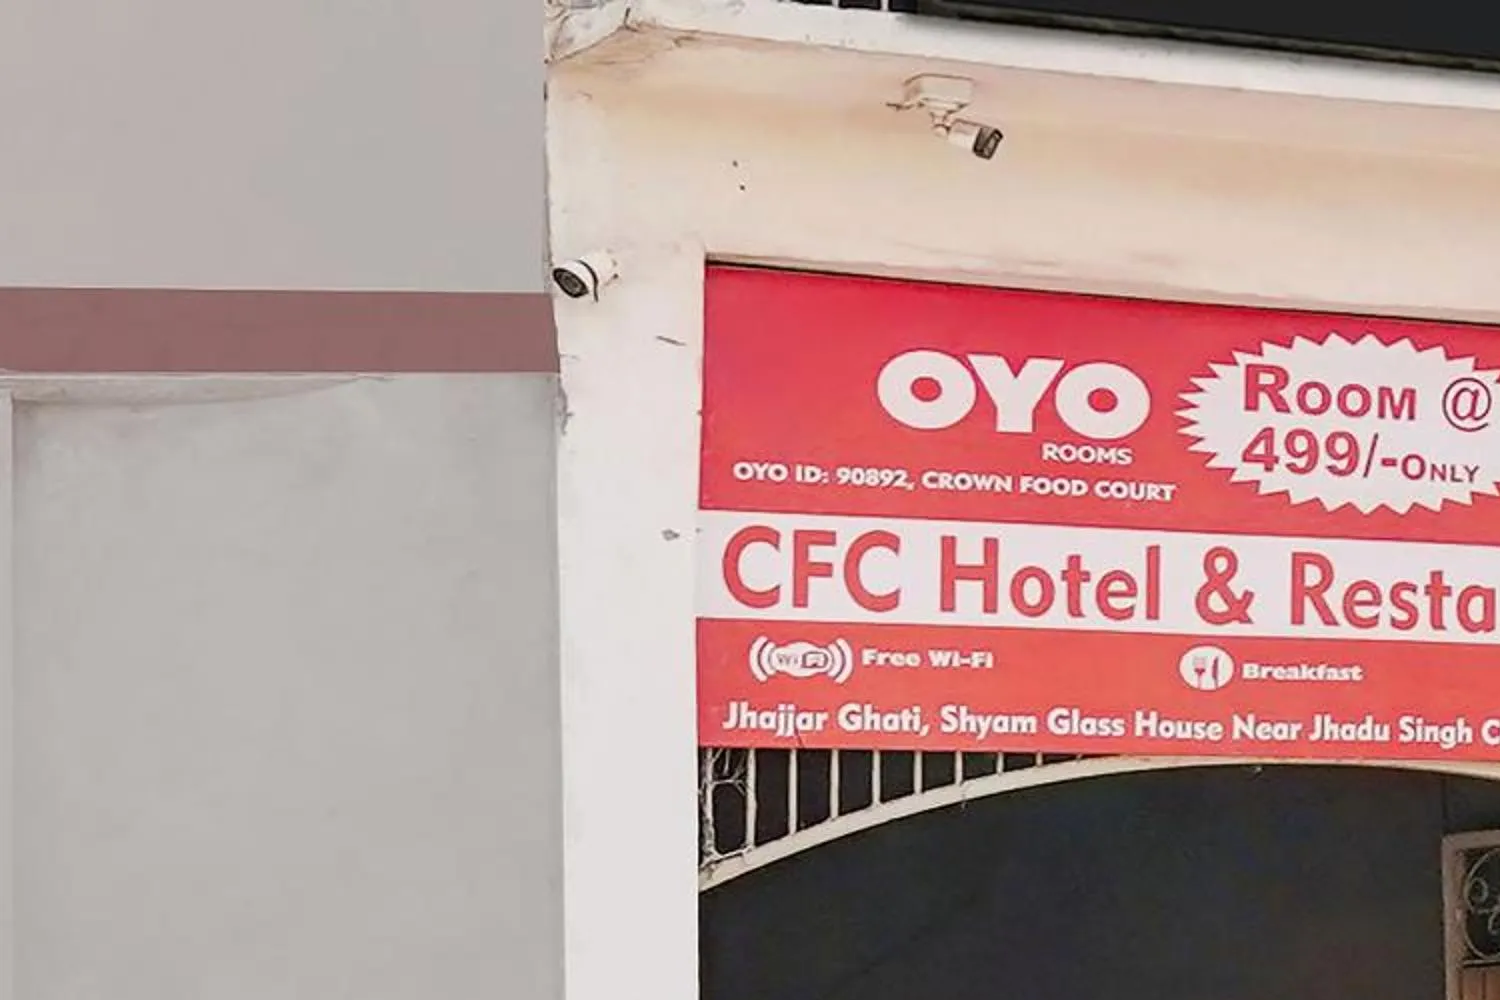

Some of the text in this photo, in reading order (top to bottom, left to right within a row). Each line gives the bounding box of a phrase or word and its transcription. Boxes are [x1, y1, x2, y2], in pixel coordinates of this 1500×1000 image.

[876, 348, 1153, 441] OYO
[1441, 376, 1493, 433] @
[1041, 442, 1133, 466] ROOMS
[733, 460, 1177, 502] OYO ID: 90892, CROWN FOOD COURT
[721, 524, 902, 613] CFC
[939, 534, 1161, 622] Hotel
[1194, 545, 1256, 627] &
[861, 647, 921, 668] Free
[1242, 662, 1364, 683] Breakfast
[723, 702, 829, 737] Jhajjar
[837, 703, 930, 737] Ghati,
[939, 705, 1038, 741] Shyam
[1047, 707, 1127, 739] Glass
[1133, 710, 1224, 742] House
[1231, 713, 1302, 743] Near
[1308, 713, 1391, 745] Jhadu
[1397, 715, 1474, 750] Singh
